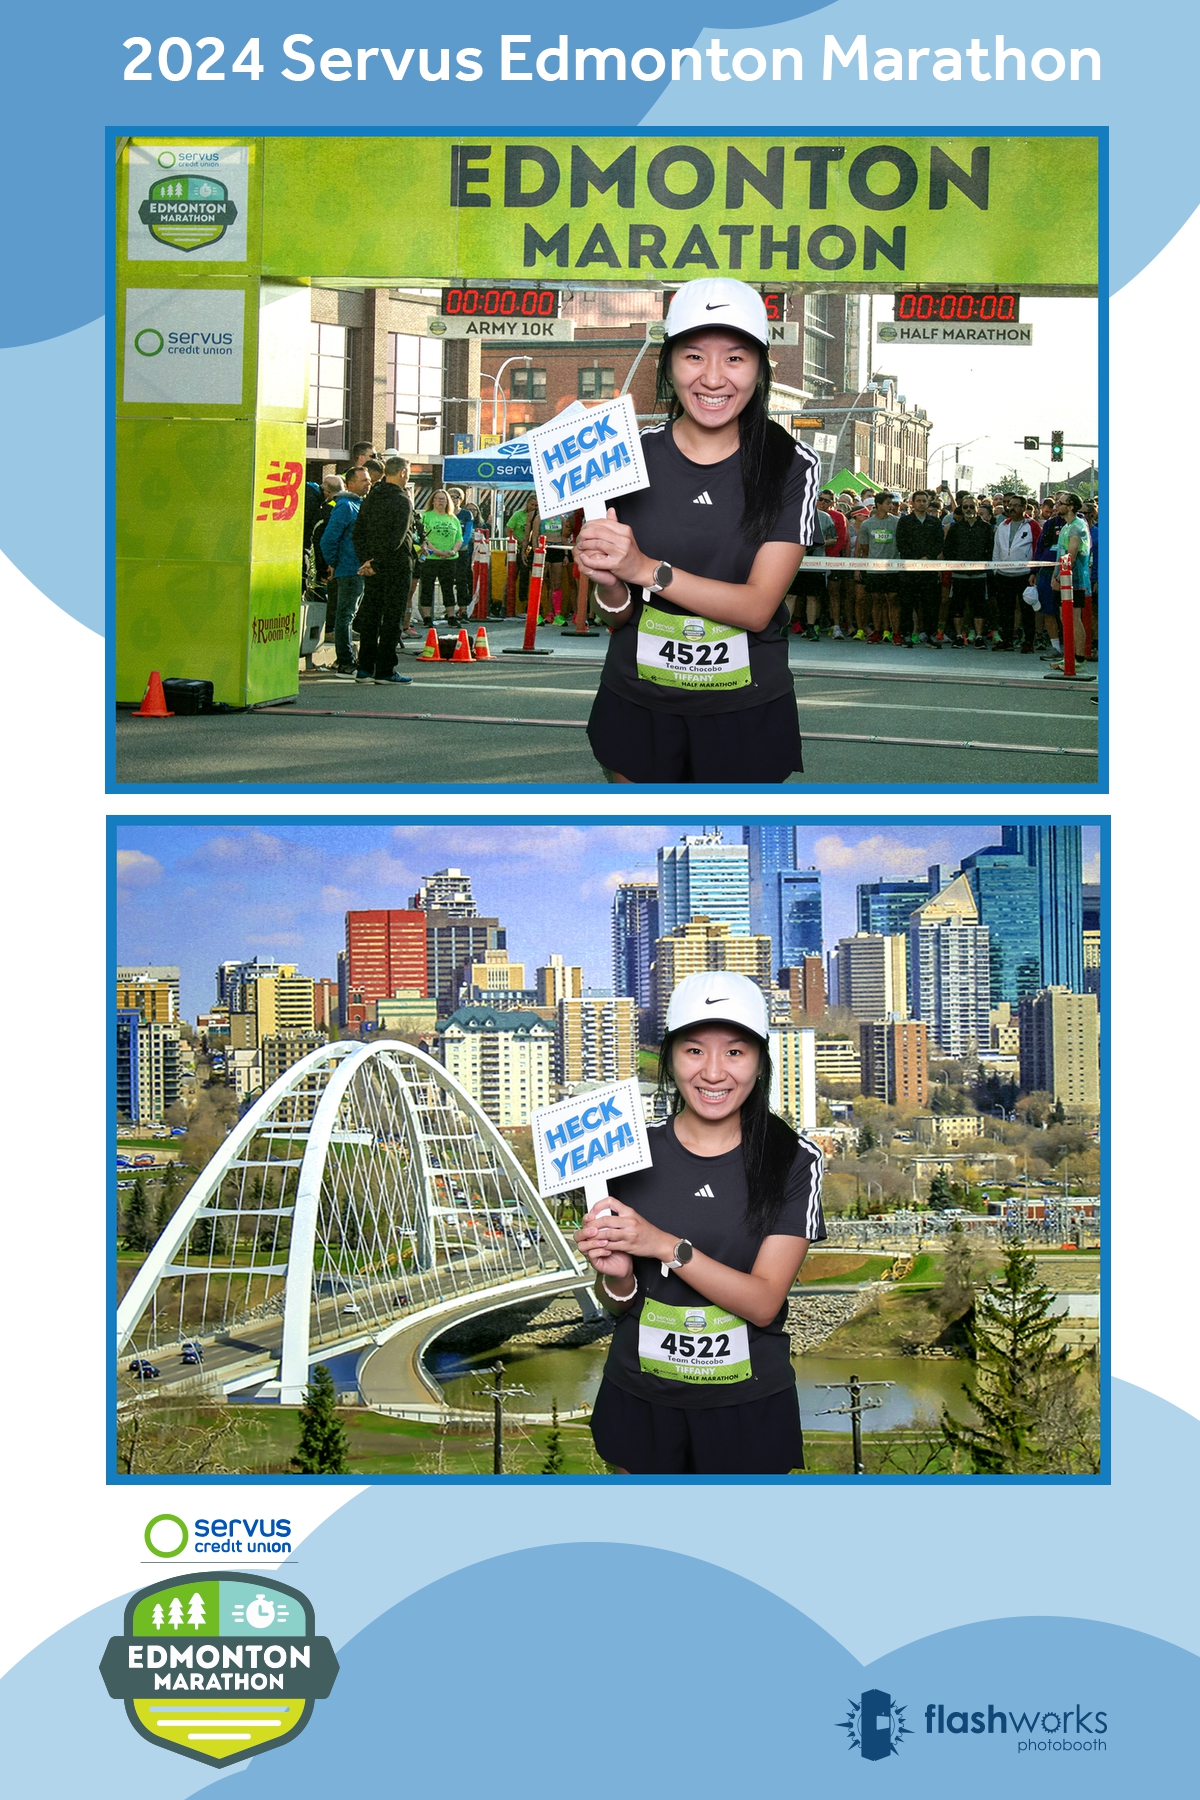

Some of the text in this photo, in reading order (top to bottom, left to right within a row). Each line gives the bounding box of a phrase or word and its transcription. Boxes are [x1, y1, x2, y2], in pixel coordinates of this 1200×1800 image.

[178, 152, 220, 161] servus
[451, 144, 991, 211] EDMONTON
[149, 203, 227, 214] EDMONTON
[160, 214, 216, 222] MARATHON
[523, 222, 907, 271] MARATHON
[465, 321, 554, 336] ARMY 10K
[900, 328, 1031, 341] HALF MARATHON
[168, 331, 233, 345] servus
[168, 345, 233, 355] credit union
[542, 414, 618, 474] HECK
[549, 441, 632, 502] YEAH!
[257, 613, 291, 641] Running
[658, 640, 730, 666] 4522
[666, 662, 687, 671] Team
[673, 672, 715, 683] TIFFANY
[699, 680, 738, 688] MARATHON
[544, 1095, 623, 1153] HECK
[550, 1122, 635, 1181] YEAH!
[660, 1332, 731, 1358] 4522
[668, 1355, 688, 1364] Team
[675, 1365, 716, 1375] TIFFANY
[701, 1374, 739, 1382] MARATHON
